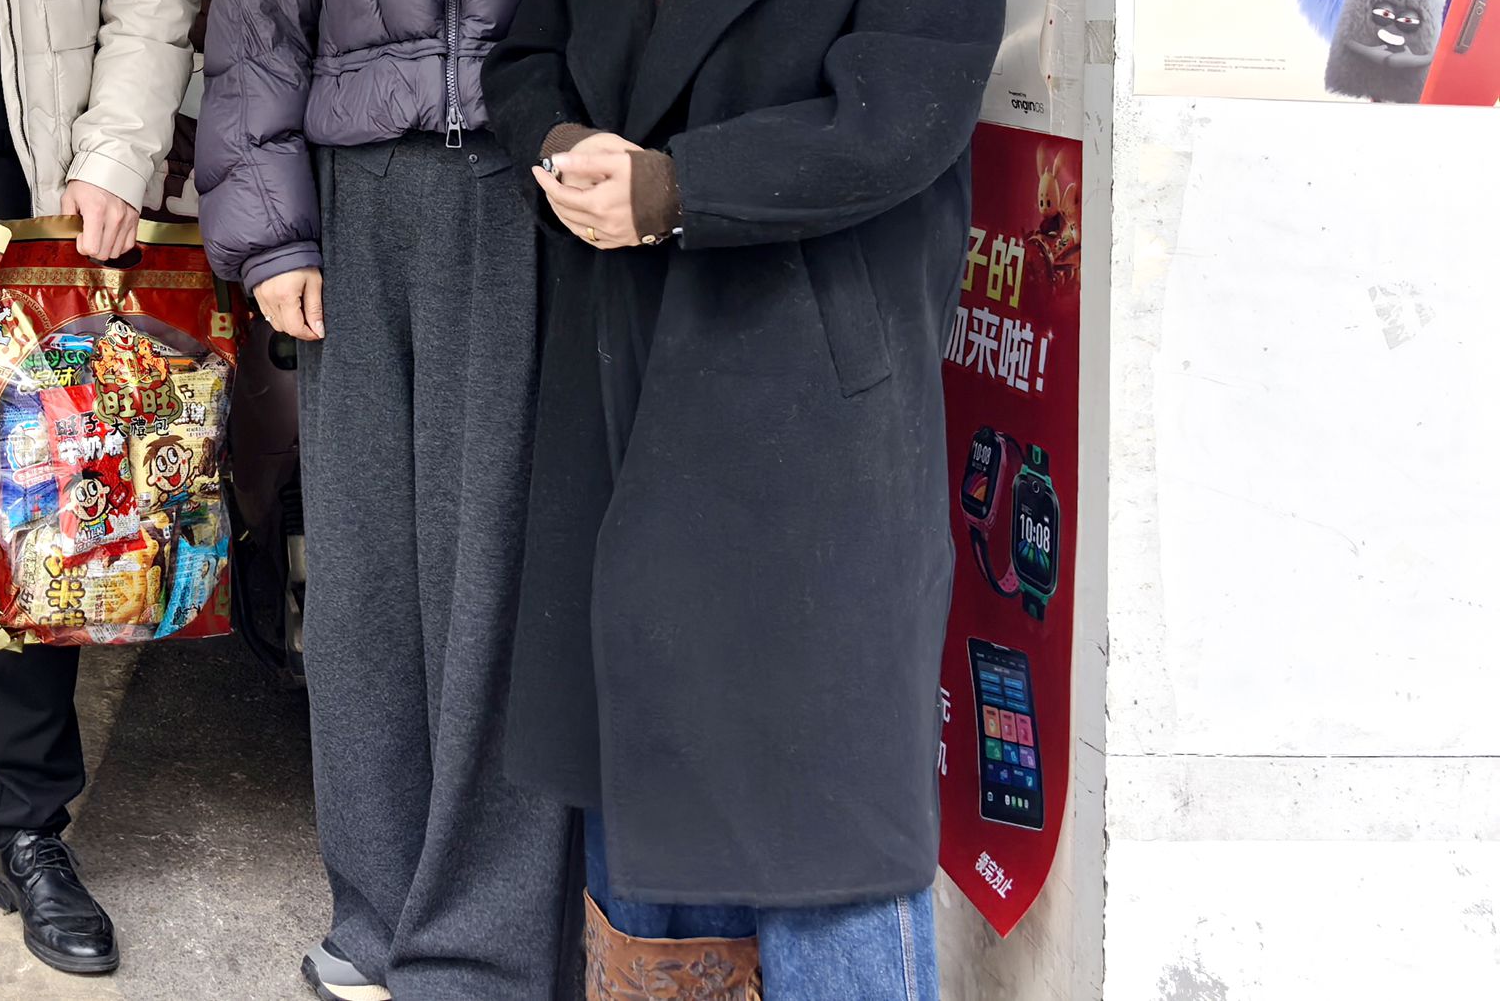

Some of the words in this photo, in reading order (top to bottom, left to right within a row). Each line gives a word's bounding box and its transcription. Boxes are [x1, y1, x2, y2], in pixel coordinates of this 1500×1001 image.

[101, 384, 172, 419] 旺旺
[110, 417, 171, 439] 大禮包
[1020, 513, 1050, 553] 10:08
